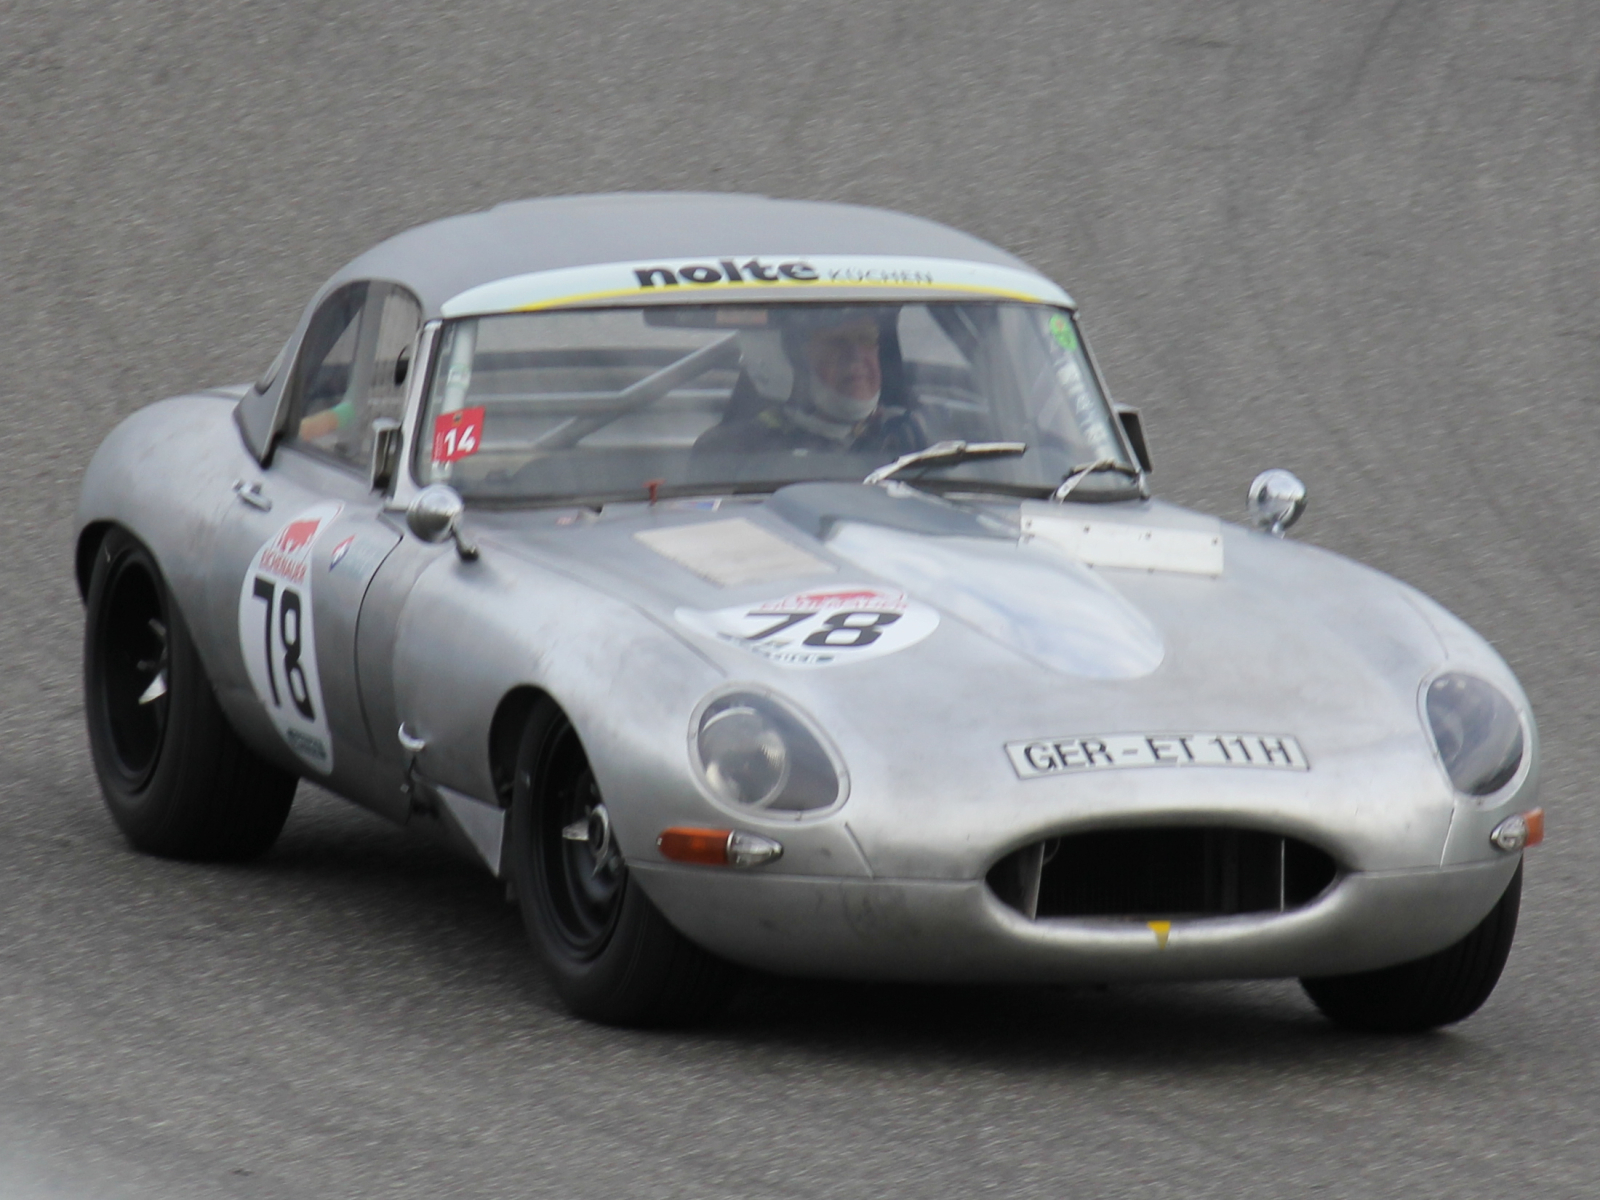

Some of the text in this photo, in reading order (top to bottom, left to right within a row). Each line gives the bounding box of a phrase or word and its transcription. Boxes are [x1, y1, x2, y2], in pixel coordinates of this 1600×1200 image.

[633, 257, 819, 288] nolte
[444, 424, 477, 457] 14
[743, 610, 904, 647] 78
[252, 573, 317, 724] 78
